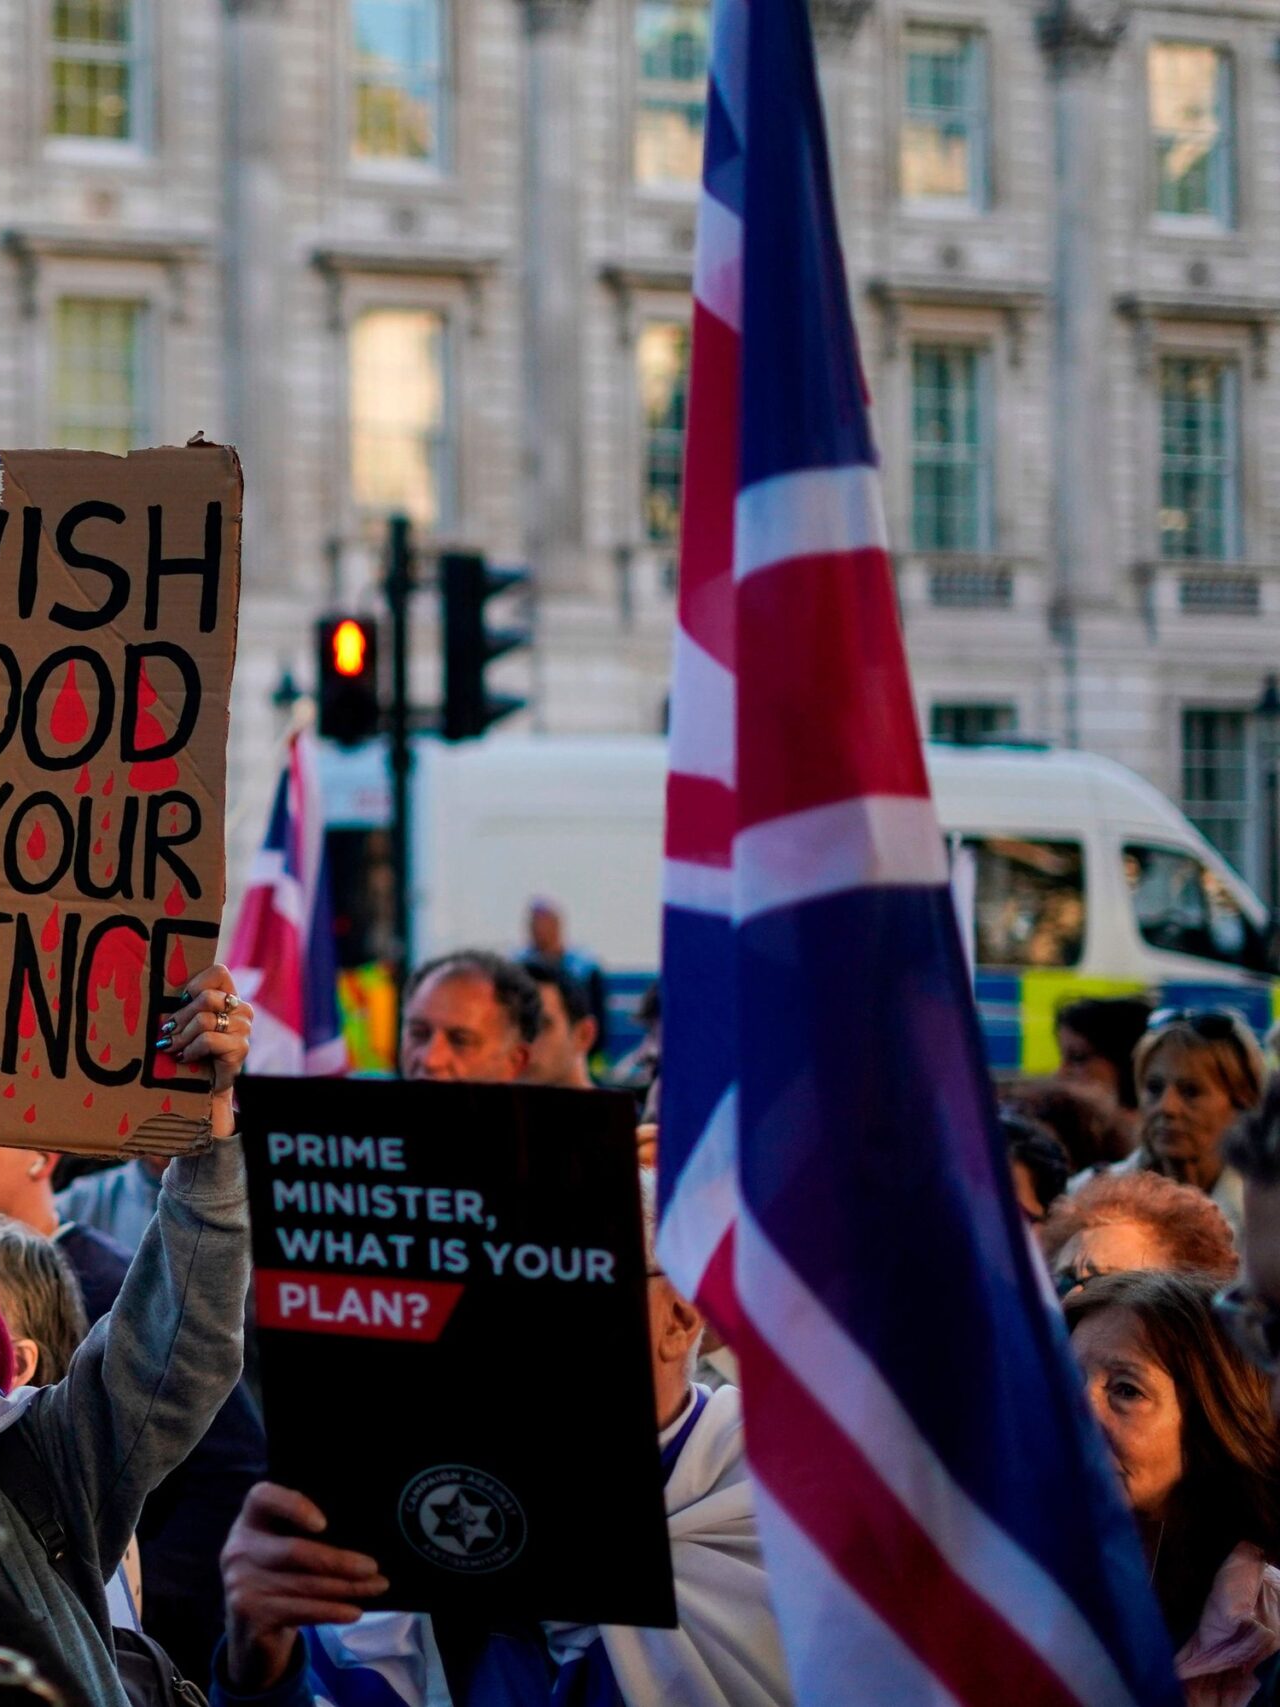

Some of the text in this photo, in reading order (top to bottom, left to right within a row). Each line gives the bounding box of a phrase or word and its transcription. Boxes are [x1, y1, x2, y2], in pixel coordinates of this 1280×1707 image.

[267, 1133, 407, 1172] PRIME
[272, 1180, 498, 1231] MINISTER,
[277, 1228, 615, 1284] WHAT IS YOUR
[278, 1283, 430, 1329] PLAN?
